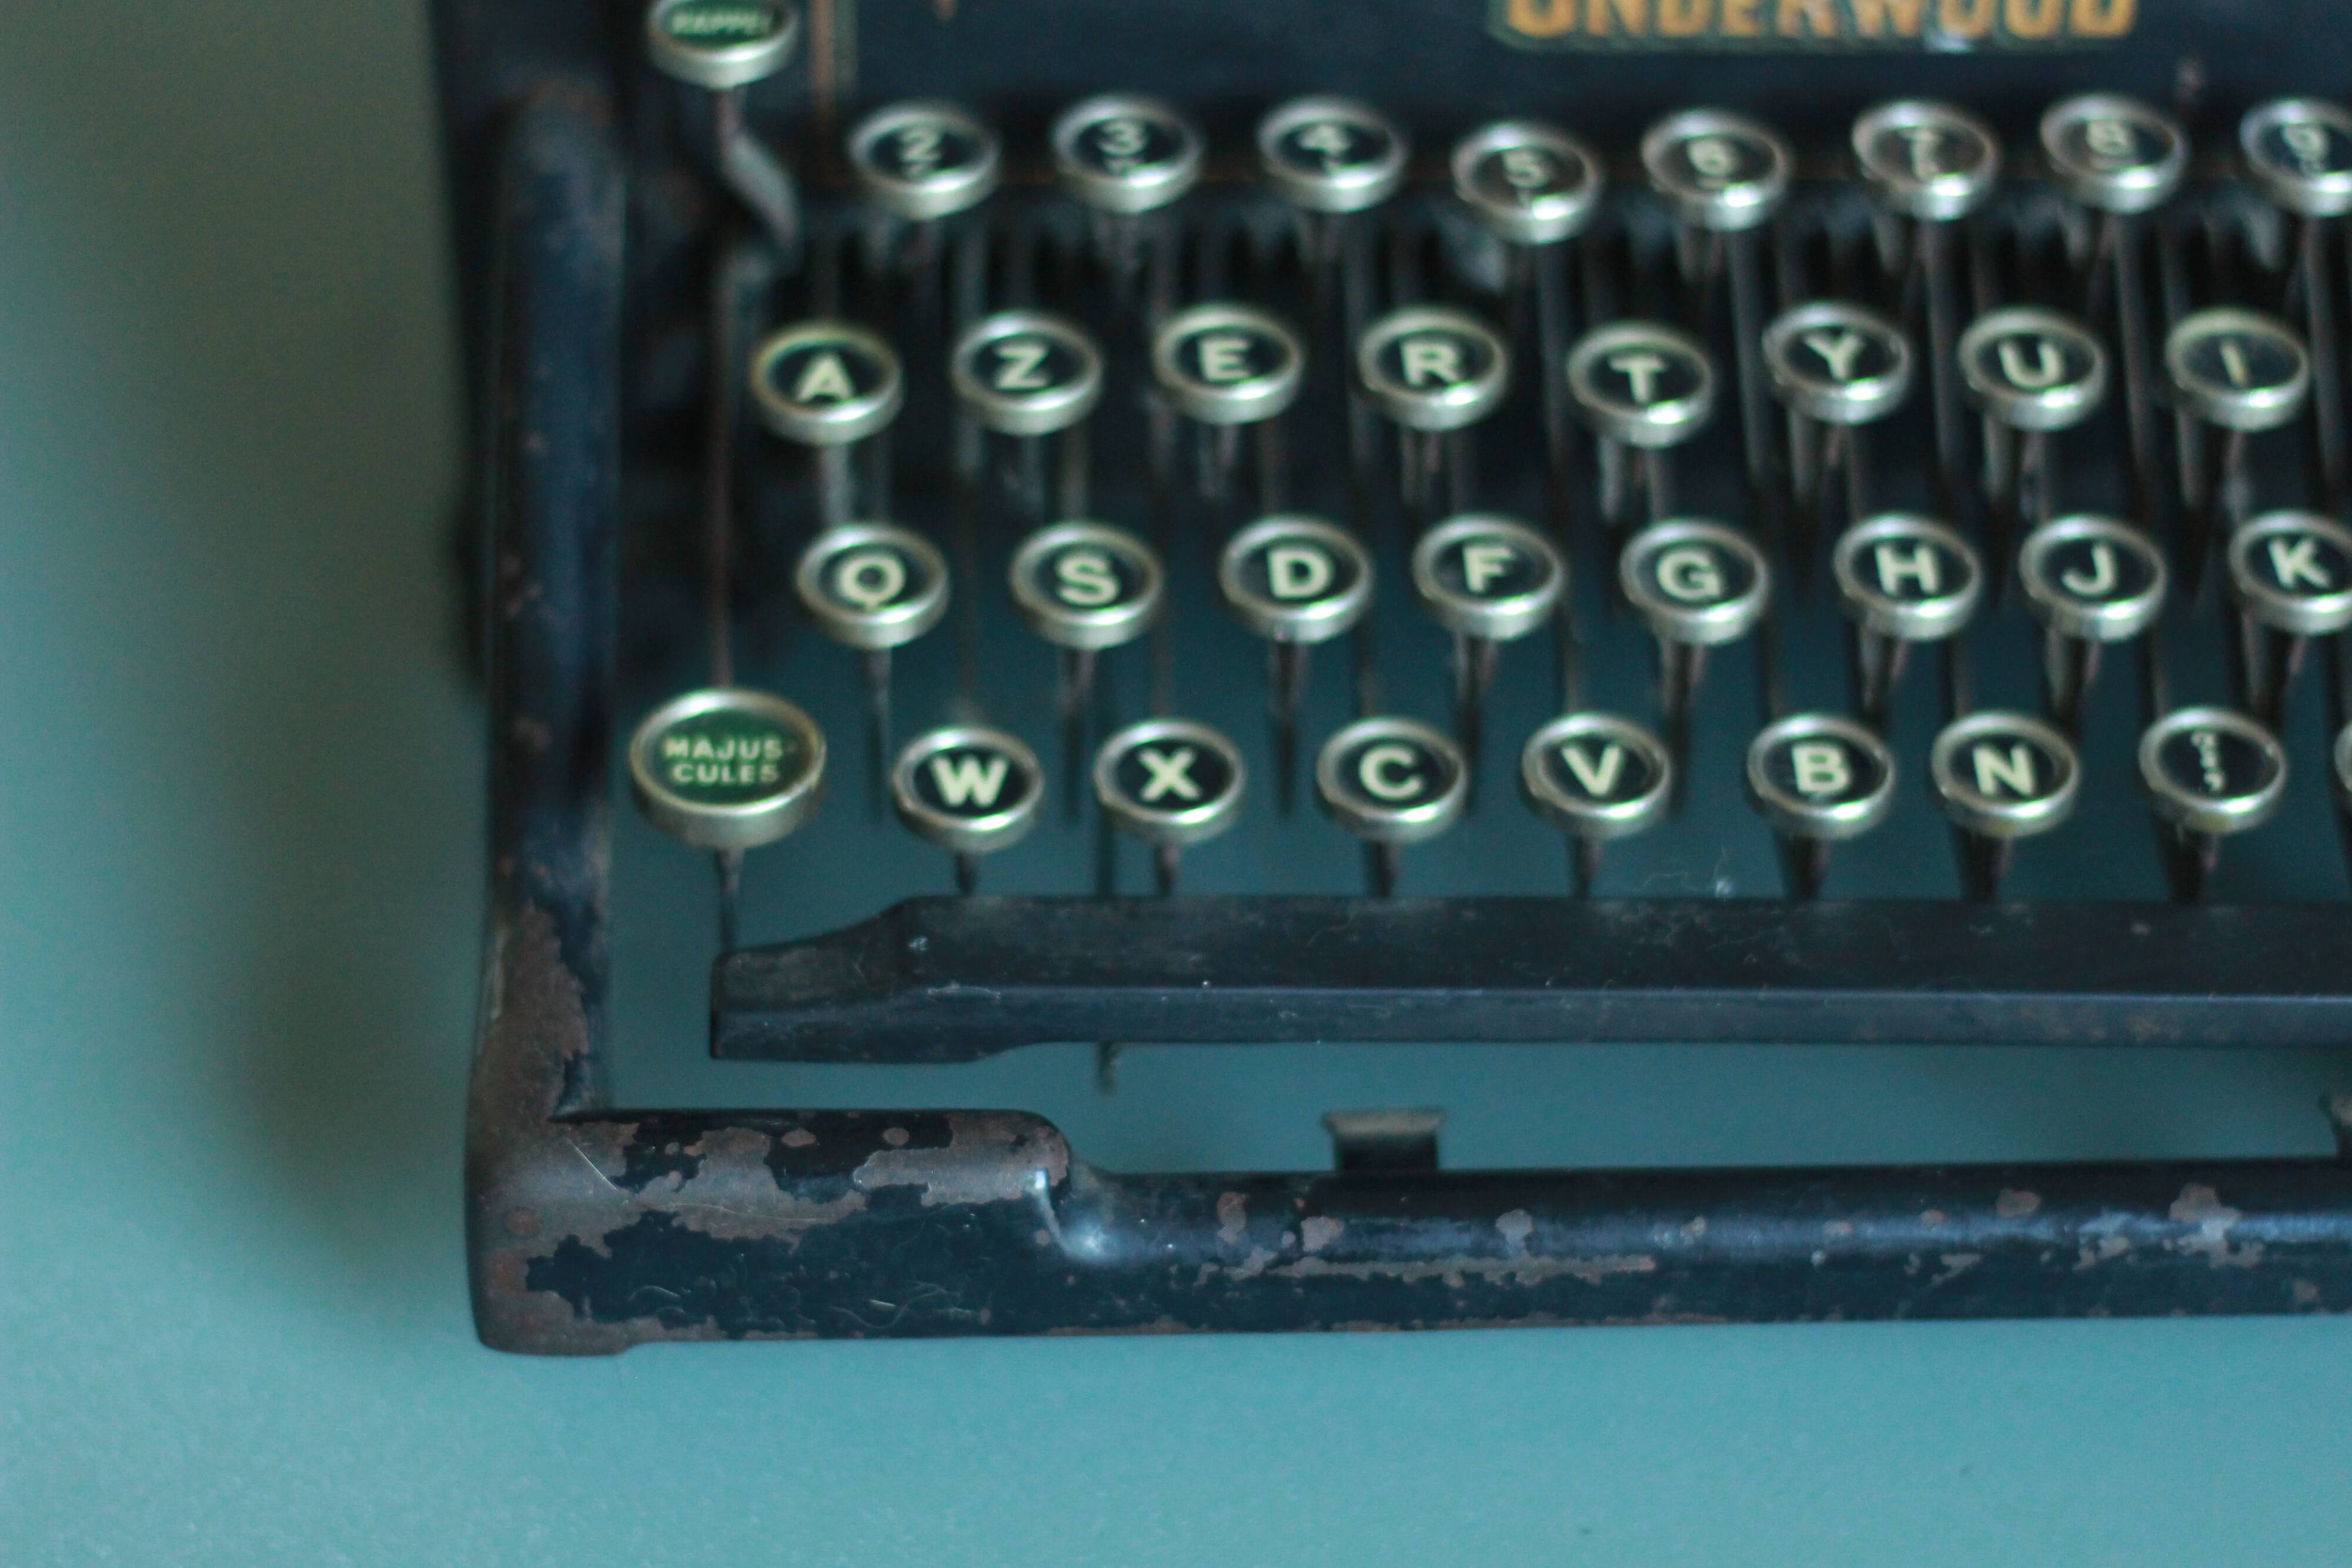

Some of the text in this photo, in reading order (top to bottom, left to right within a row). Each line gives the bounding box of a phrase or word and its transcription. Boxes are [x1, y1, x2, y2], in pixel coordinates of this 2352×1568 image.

[899, 125, 941, 162] 2
[1097, 121, 1148, 155] 3
[1686, 140, 1738, 175] 6
[1502, 151, 1549, 187] 5
[795, 353, 856, 402] A
[995, 346, 1050, 389] Z
[1197, 337, 1252, 382] E
[1400, 341, 1461, 385] R
[1609, 357, 1667, 402] T
[1804, 333, 1863, 379] Y
[2000, 342, 2064, 388] U
[2219, 340, 2249, 385] I
[837, 551, 905, 610] Q
[1057, 553, 1120, 606] S
[1266, 549, 1334, 599] D
[1462, 546, 1517, 594] F
[1655, 549, 1722, 600] G
[1875, 544, 1941, 596] H
[2062, 544, 2116, 596] J
[2269, 538, 2331, 587] K
[671, 762, 780, 785] CULES
[930, 755, 1009, 808] W
[1139, 747, 1202, 803] X
[1359, 745, 1424, 800] C
[1561, 744, 1624, 796] V
[1790, 744, 1850, 794] B
[1972, 744, 2036, 797] N
